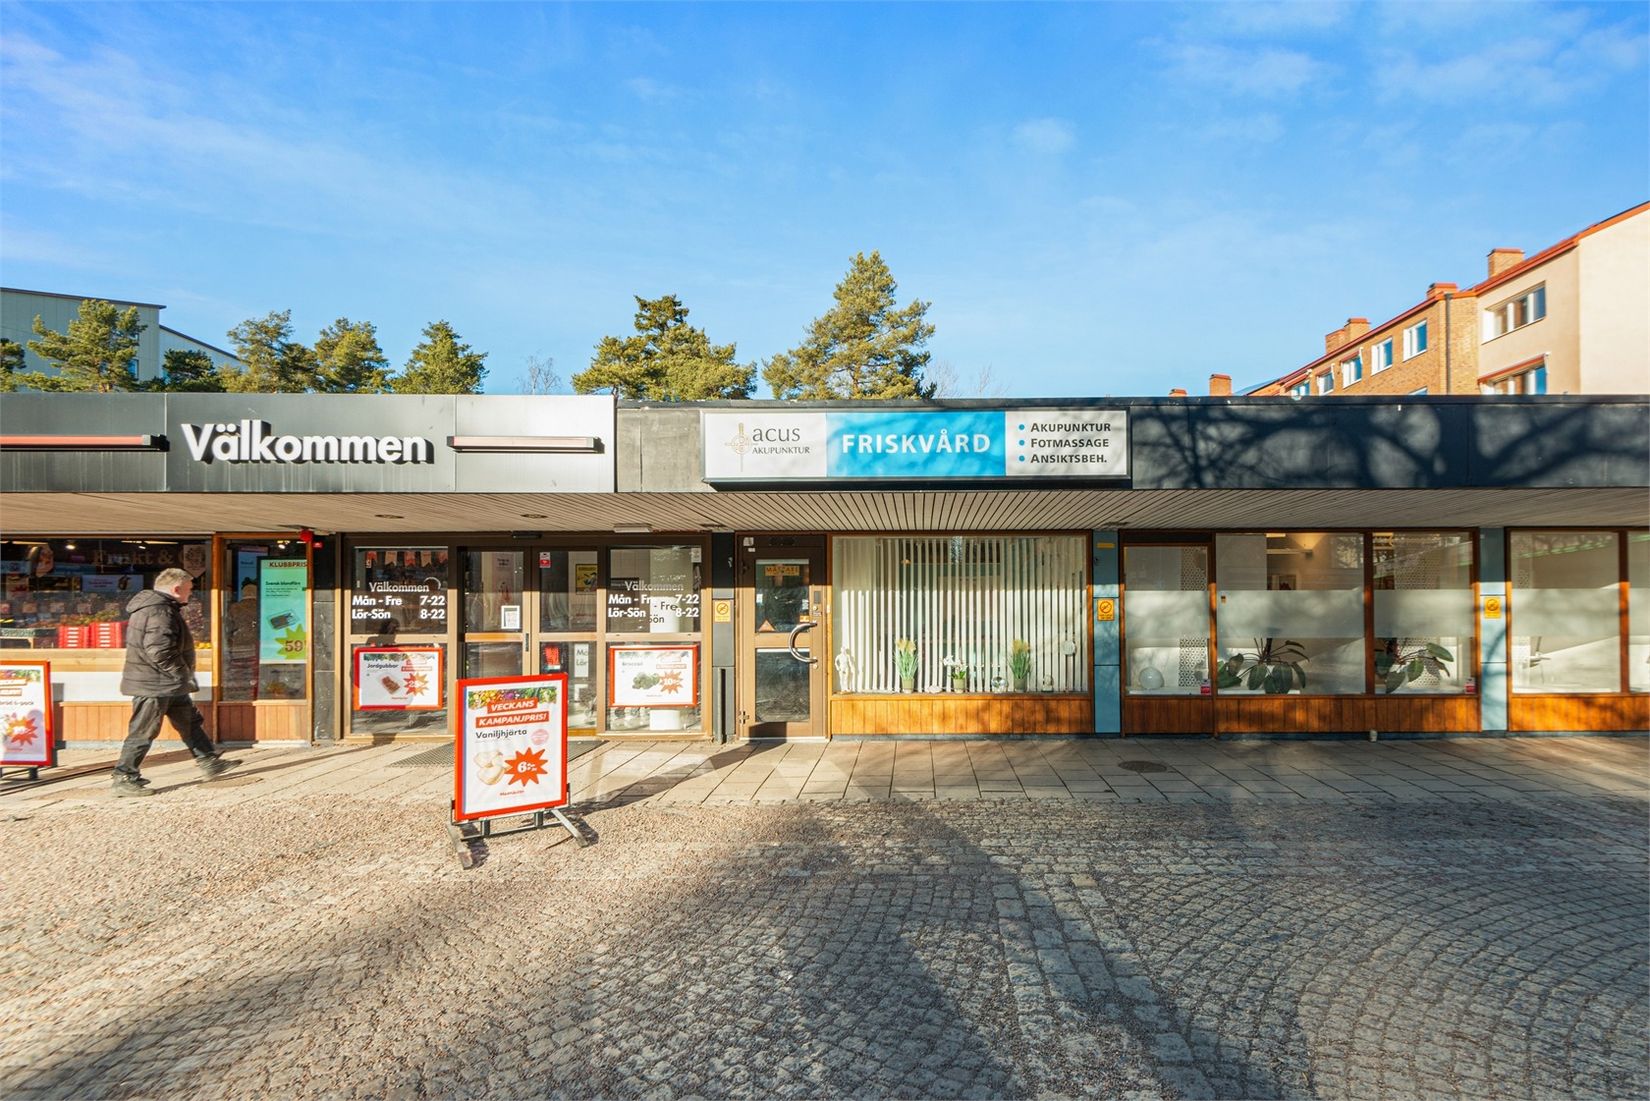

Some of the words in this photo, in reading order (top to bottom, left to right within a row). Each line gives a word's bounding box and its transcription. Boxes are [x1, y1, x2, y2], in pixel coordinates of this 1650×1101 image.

[1030, 422, 1112, 433] AKUPUNKTUR
[752, 427, 801, 442] acus
[181, 419, 430, 462] Välkommen
[842, 428, 992, 454] FRISKVÅRD
[1030, 437, 1110, 449] FOTMASSAGE
[752, 446, 811, 455] AKUPUNKTUR
[1030, 453, 1108, 464] ANSIKTSBEH.
[369, 581, 430, 592] Välkommen
[624, 580, 684, 591] Välkommen
[352, 594, 376, 605] Mån
[385, 595, 403, 606] Fre
[420, 595, 446, 606] 7-22
[608, 593, 631, 604] Mån
[675, 594, 700, 604] 7-22
[352, 608, 391, 619] Lör-Sön
[420, 608, 446, 619] 8-22
[608, 607, 646, 618] Lör-Sön
[675, 607, 700, 618] 8-22
[491, 699, 535, 712] VECKANS
[478, 713, 547, 727] KAMPANJPRIS!
[475, 728, 528, 740] Vaniljhjärta
